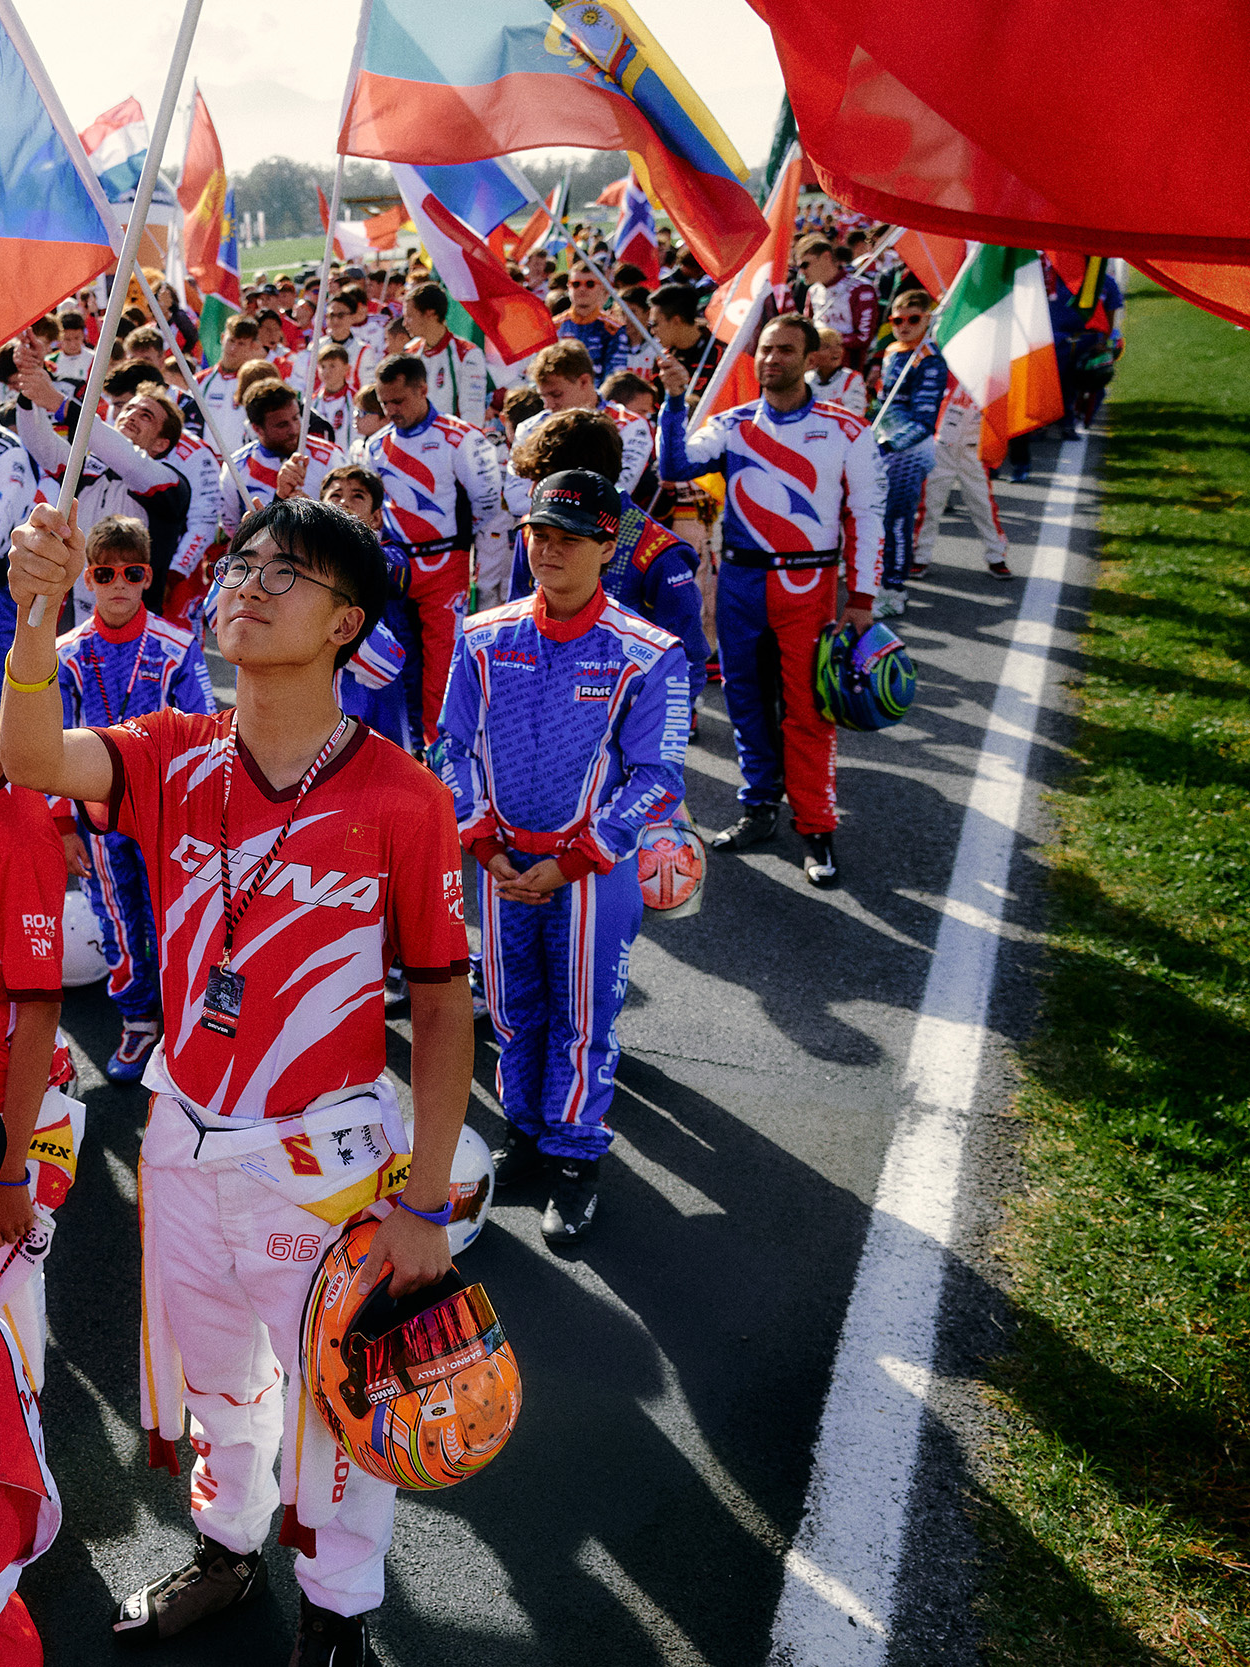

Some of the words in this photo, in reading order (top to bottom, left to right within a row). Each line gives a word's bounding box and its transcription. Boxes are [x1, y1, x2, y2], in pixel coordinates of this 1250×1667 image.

[540, 497, 581, 506] RACING
[542, 489, 582, 500] ROTAX
[470, 632, 492, 645] OMP
[493, 649, 538, 666] ROTAX
[629, 645, 653, 660] OMP
[660, 676, 691, 766] REPUBLIC
[332, 724, 344, 742] ROTAX
[170, 833, 380, 914] CHINA
[207, 1022, 229, 1033] DRIVER
[29, 1139, 72, 1161] HRX
[267, 1233, 321, 1262] 66
[327, 1275, 343, 1304] BELL
[446, 1348, 482, 1372] SARNO,
[417, 1364, 445, 1380] ITALY
[368, 1386, 397, 1403] RMC
[235, 1563, 251, 1578] OMP
[123, 1589, 143, 1619] OMP
